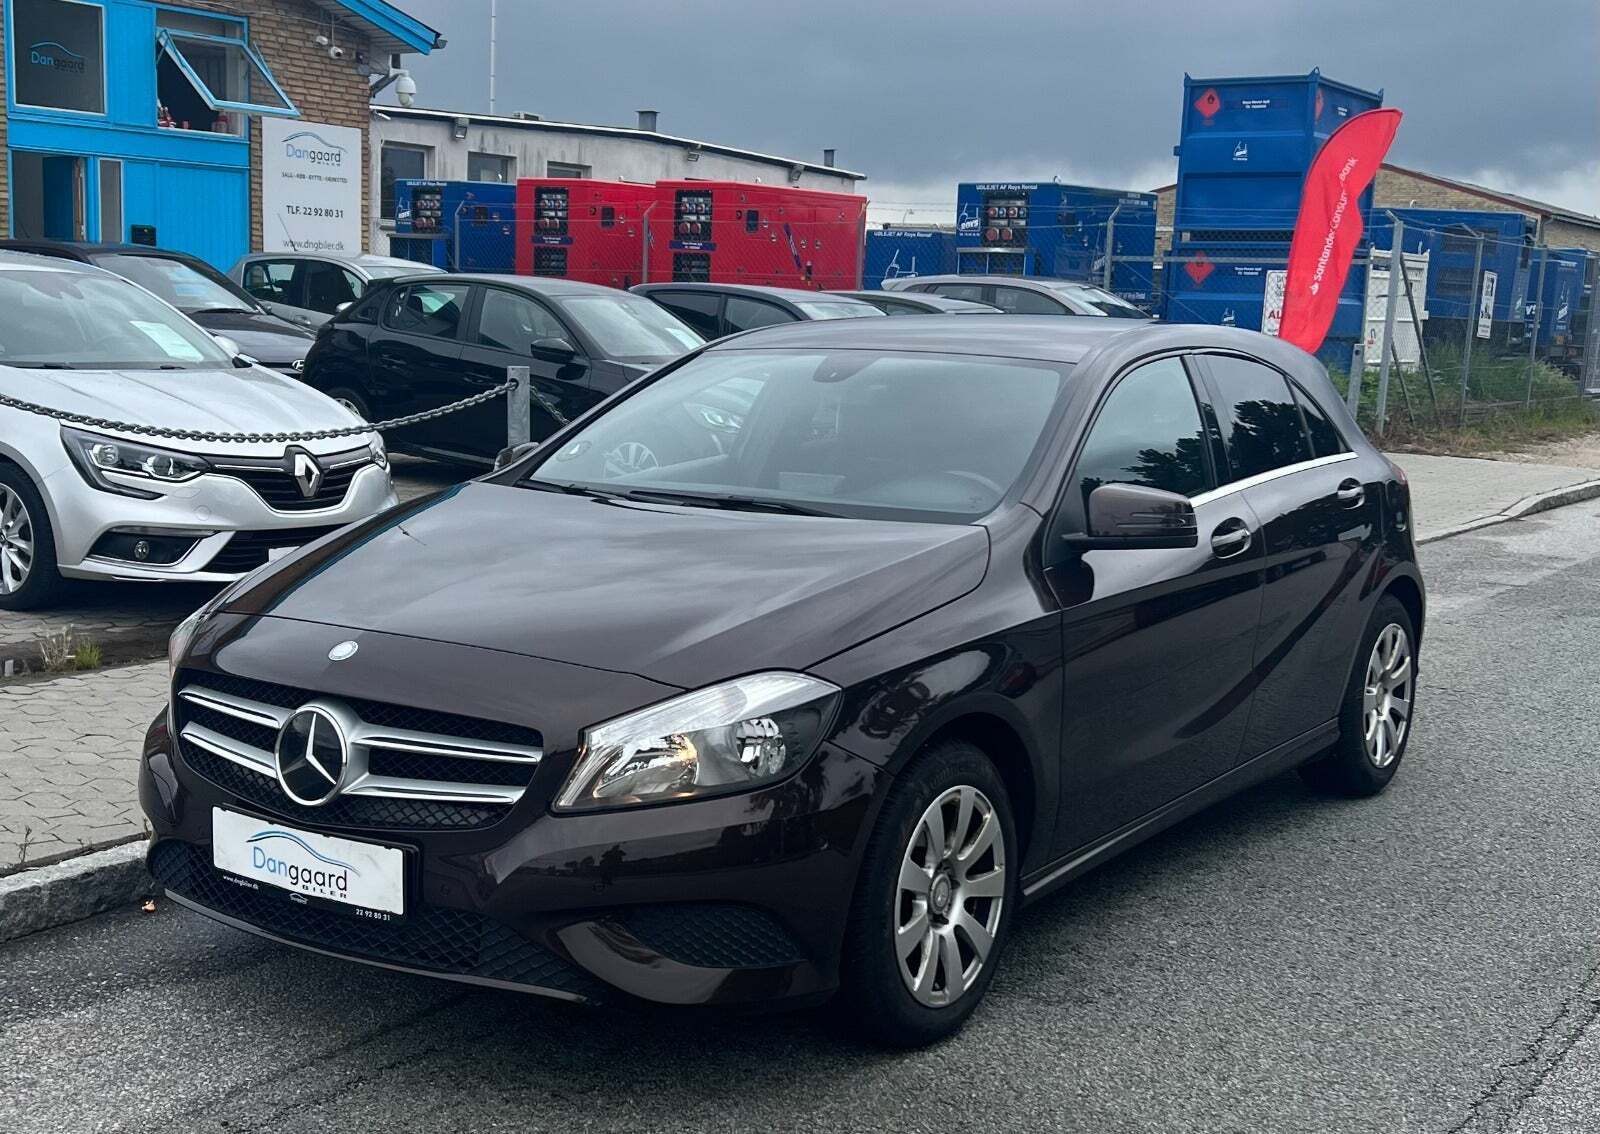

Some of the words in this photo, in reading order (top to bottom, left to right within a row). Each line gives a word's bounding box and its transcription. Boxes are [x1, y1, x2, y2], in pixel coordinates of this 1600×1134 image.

[286, 143, 341, 164] Dangaard
[286, 204, 301, 215] TLF.
[303, 206, 312, 216] 22
[313, 207, 323, 217] 92
[324, 208, 334, 218] 80
[335, 209, 344, 219] 31
[253, 847, 347, 891] Dangaard
[301, 885, 348, 899] BILER
[355, 907, 364, 917] 22
[364, 909, 373, 918] 92
[382, 913, 391, 922] 31
